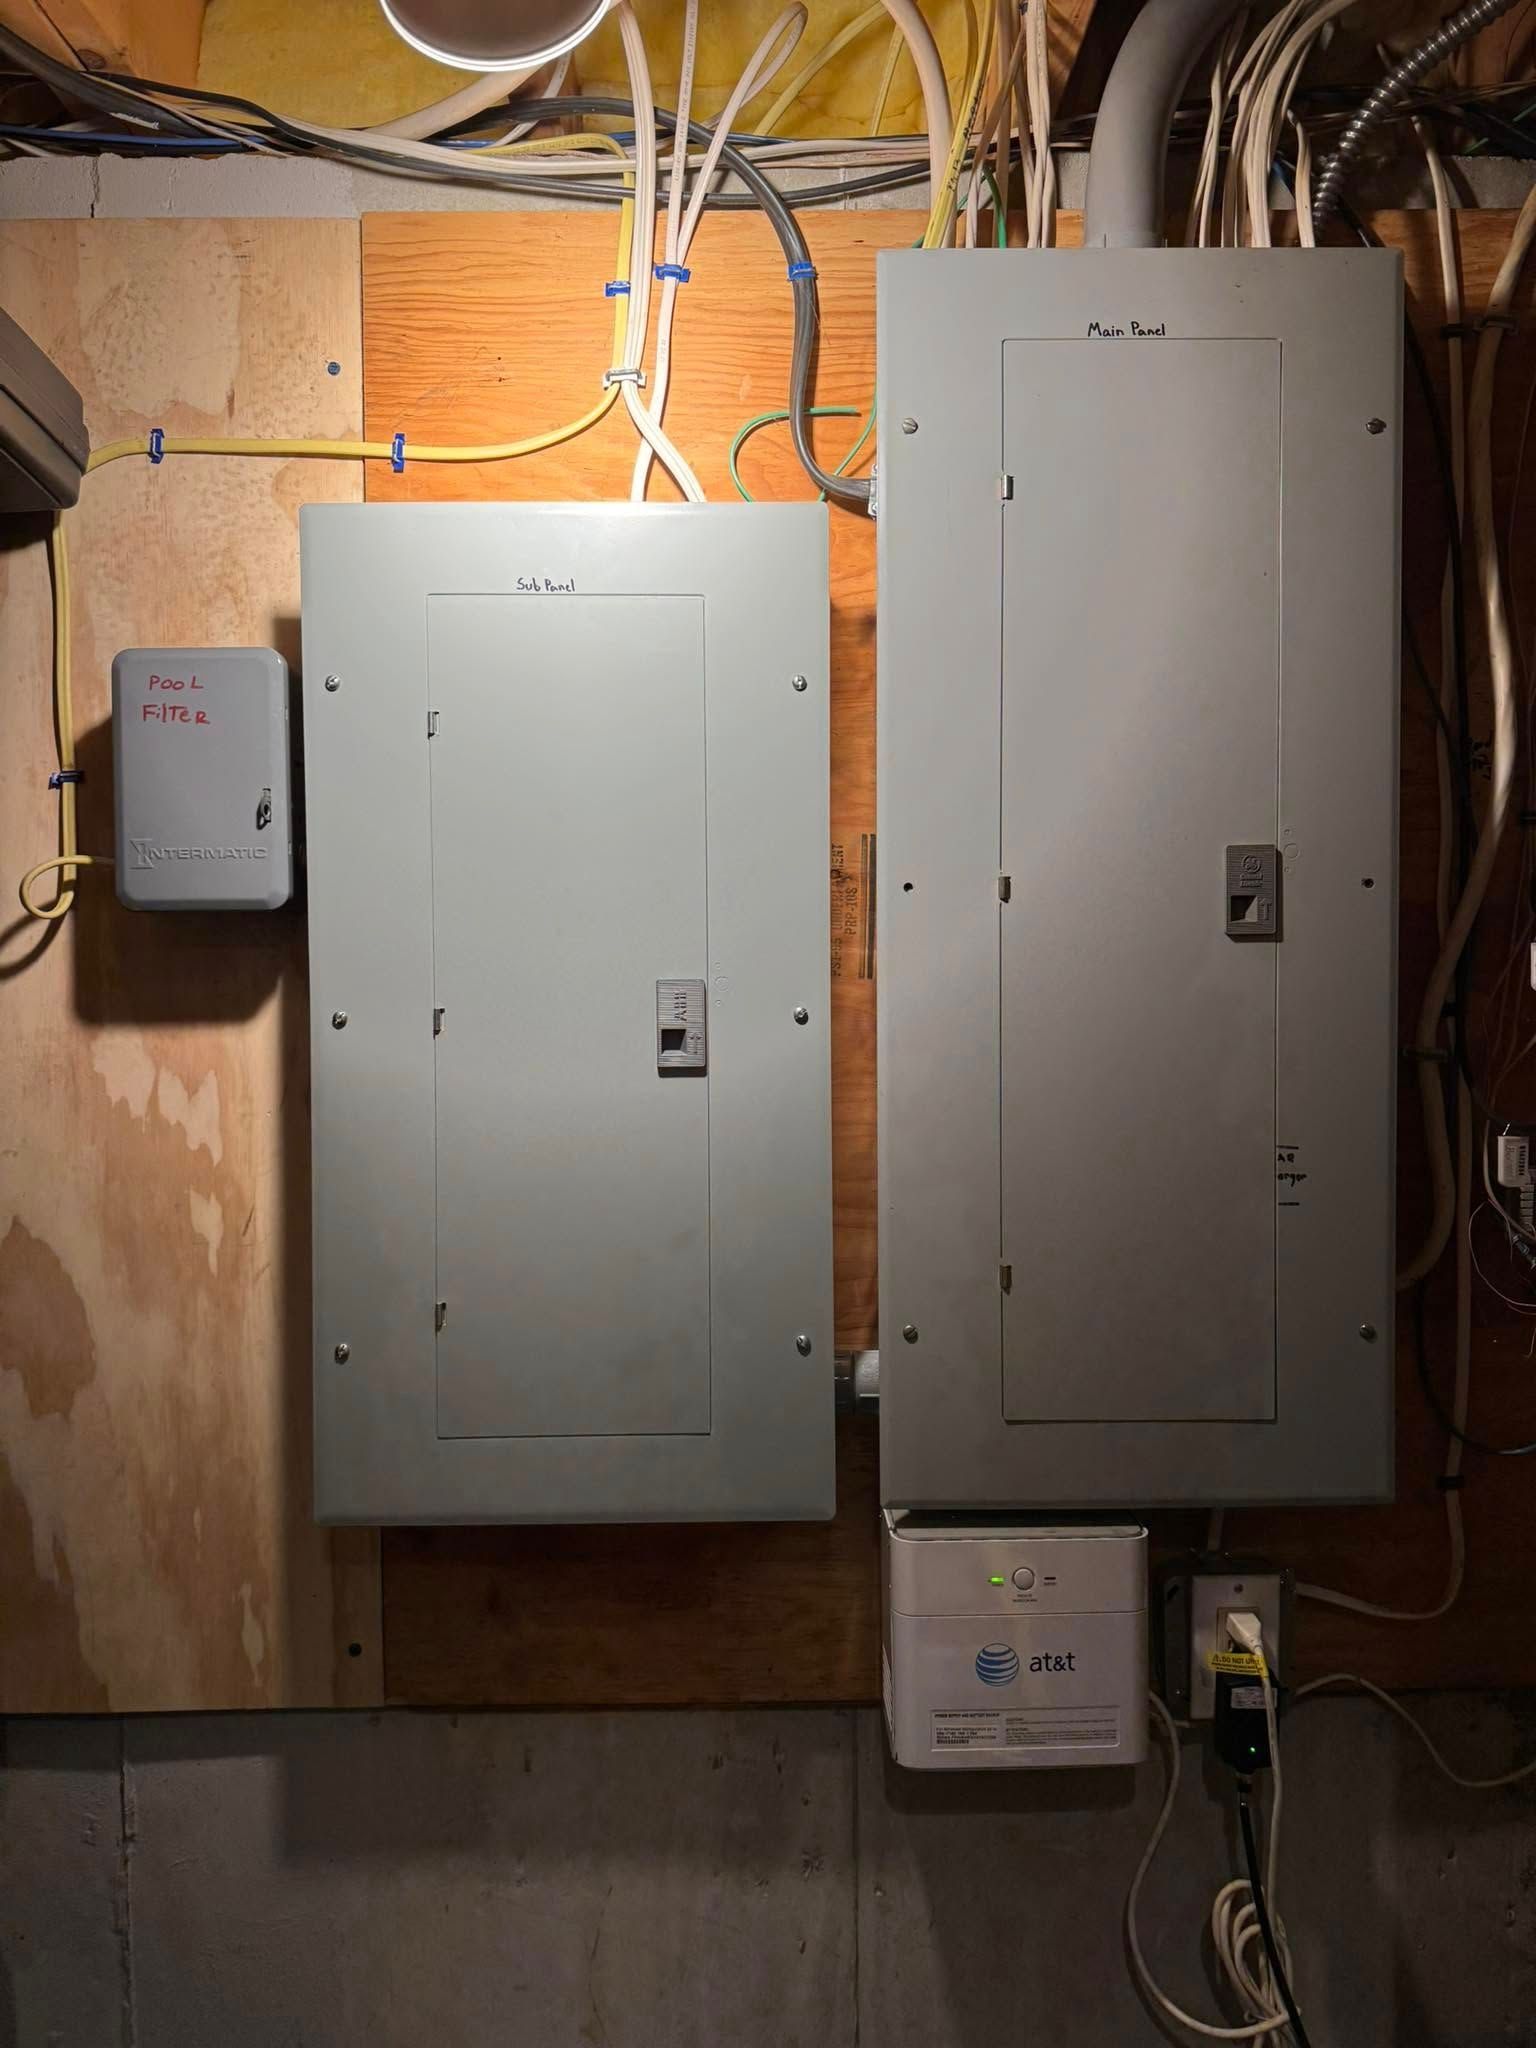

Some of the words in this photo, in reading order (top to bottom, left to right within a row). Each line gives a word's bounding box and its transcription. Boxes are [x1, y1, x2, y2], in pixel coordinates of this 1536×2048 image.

[1088, 321, 1125, 337] Main
[1131, 320, 1166, 336] Panel
[516, 577, 541, 592] Sub
[544, 578, 576, 592] Panel
[129, 837, 268, 870] INTERMATIC
[1029, 1652, 1076, 1673] at&t
